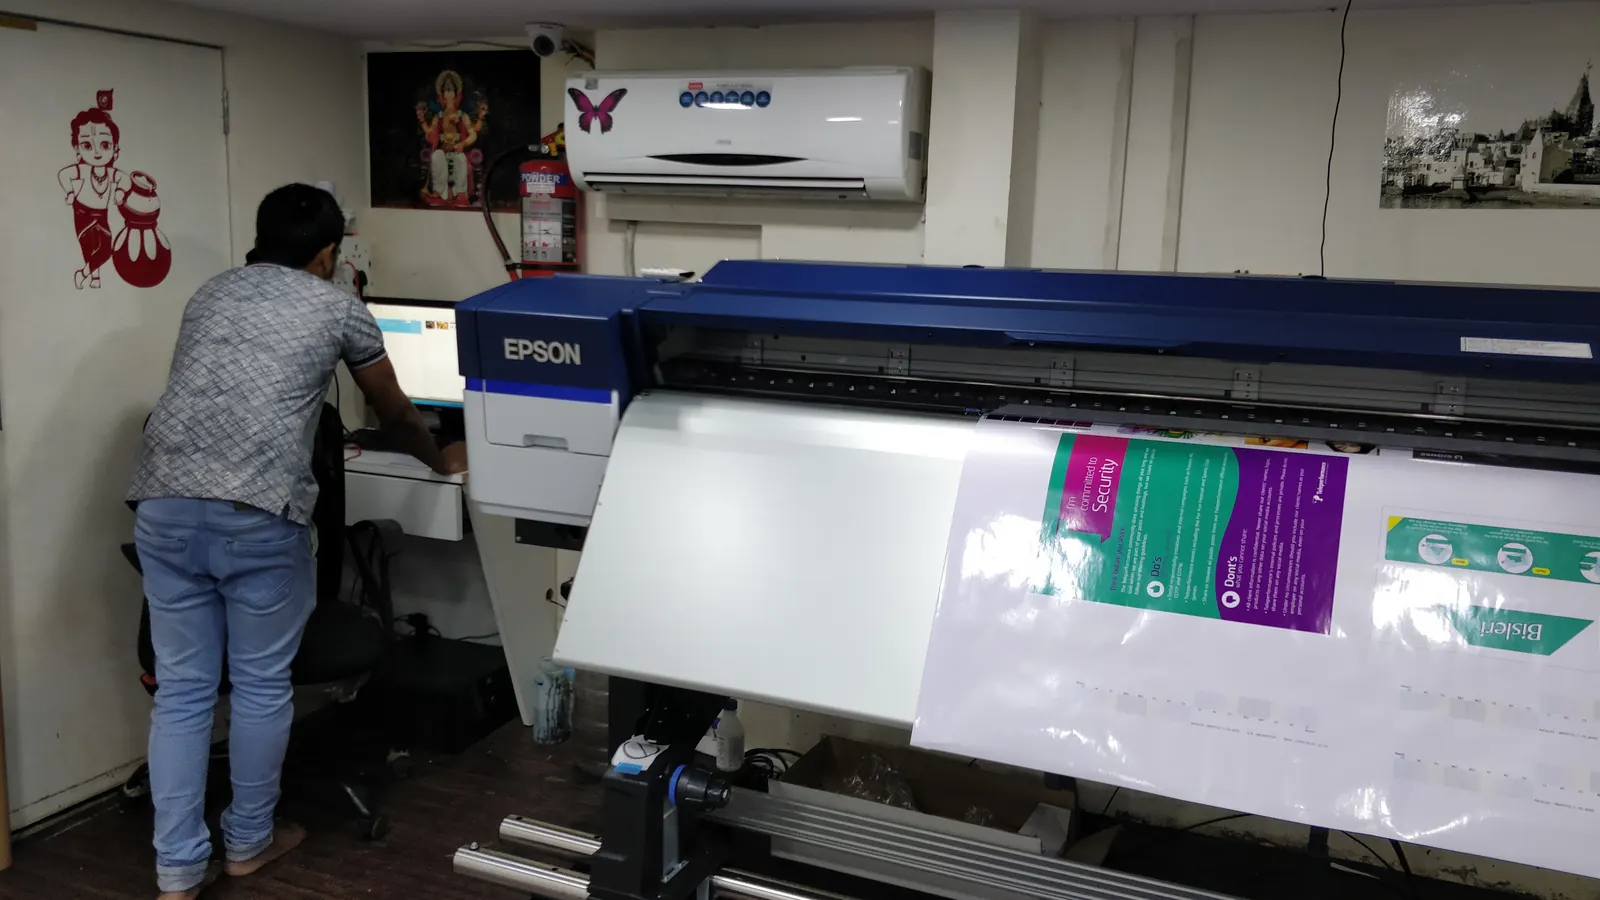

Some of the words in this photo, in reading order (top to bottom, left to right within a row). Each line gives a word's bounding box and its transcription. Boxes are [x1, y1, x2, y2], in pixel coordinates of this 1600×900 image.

[521, 173, 560, 184] POWDER
[503, 338, 581, 365] EPSON
[1080, 465, 1095, 511] committed
[1092, 459, 1118, 512] Security
[1317, 462, 1326, 494] Teleperformance
[1150, 557, 1162, 576] Do's
[1225, 557, 1237, 587] Dont's
[1480, 621, 1543, 641] Bisleri
